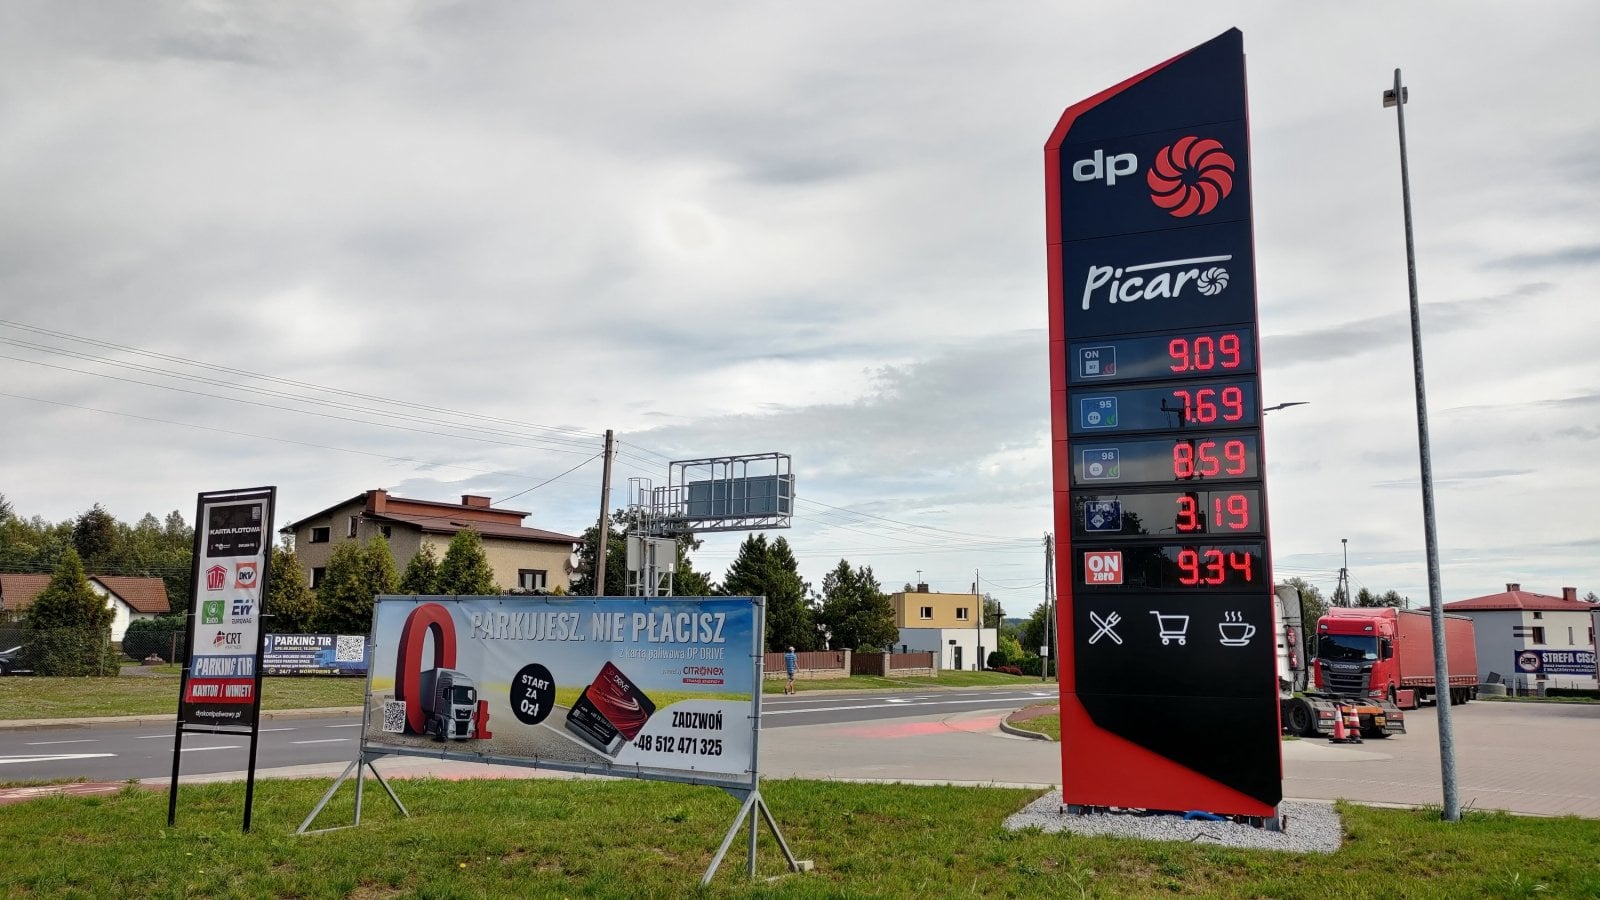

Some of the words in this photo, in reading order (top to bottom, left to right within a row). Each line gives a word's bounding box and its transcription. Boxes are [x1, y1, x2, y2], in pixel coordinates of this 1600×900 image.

[1073, 149, 1138, 186] dp
[1084, 350, 1099, 359] ON
[1169, 334, 1240, 372] 9.09
[1099, 400, 1112, 409] 95
[1173, 386, 1243, 423] 7.69
[1101, 451, 1114, 460] 98
[1173, 440, 1246, 478] 8.59
[1090, 503, 1110, 513] LPG
[1176, 494, 1248, 530] 3.19
[231, 526, 261, 534] FLOTOWA
[1088, 555, 1119, 572] ON
[1178, 549, 1251, 585] 9.34
[239, 571, 254, 580] DKV
[1093, 571, 1115, 582] zero
[470, 612, 585, 641] PARKUJESZ.
[592, 612, 625, 643] NIE
[632, 612, 727, 644] PŁACISZ
[226, 632, 242, 645] CRT
[274, 636, 315, 646] PARKING
[316, 636, 332, 646] TIR
[699, 648, 725, 660] DRIVE
[1542, 652, 1574, 663] STREFA
[1576, 652, 1596, 664] CISZ
[195, 657, 236, 676] PARKING
[237, 657, 253, 676] TIR
[521, 674, 550, 691] START
[613, 674, 630, 692] DRIVE
[192, 684, 219, 697] KANTOR
[525, 687, 537, 700] ZA
[672, 709, 723, 730] ZADZWOŃ
[633, 734, 653, 752] +48
[655, 735, 675, 753] 512
[677, 737, 697, 755] 471
[700, 738, 723, 756] 325
